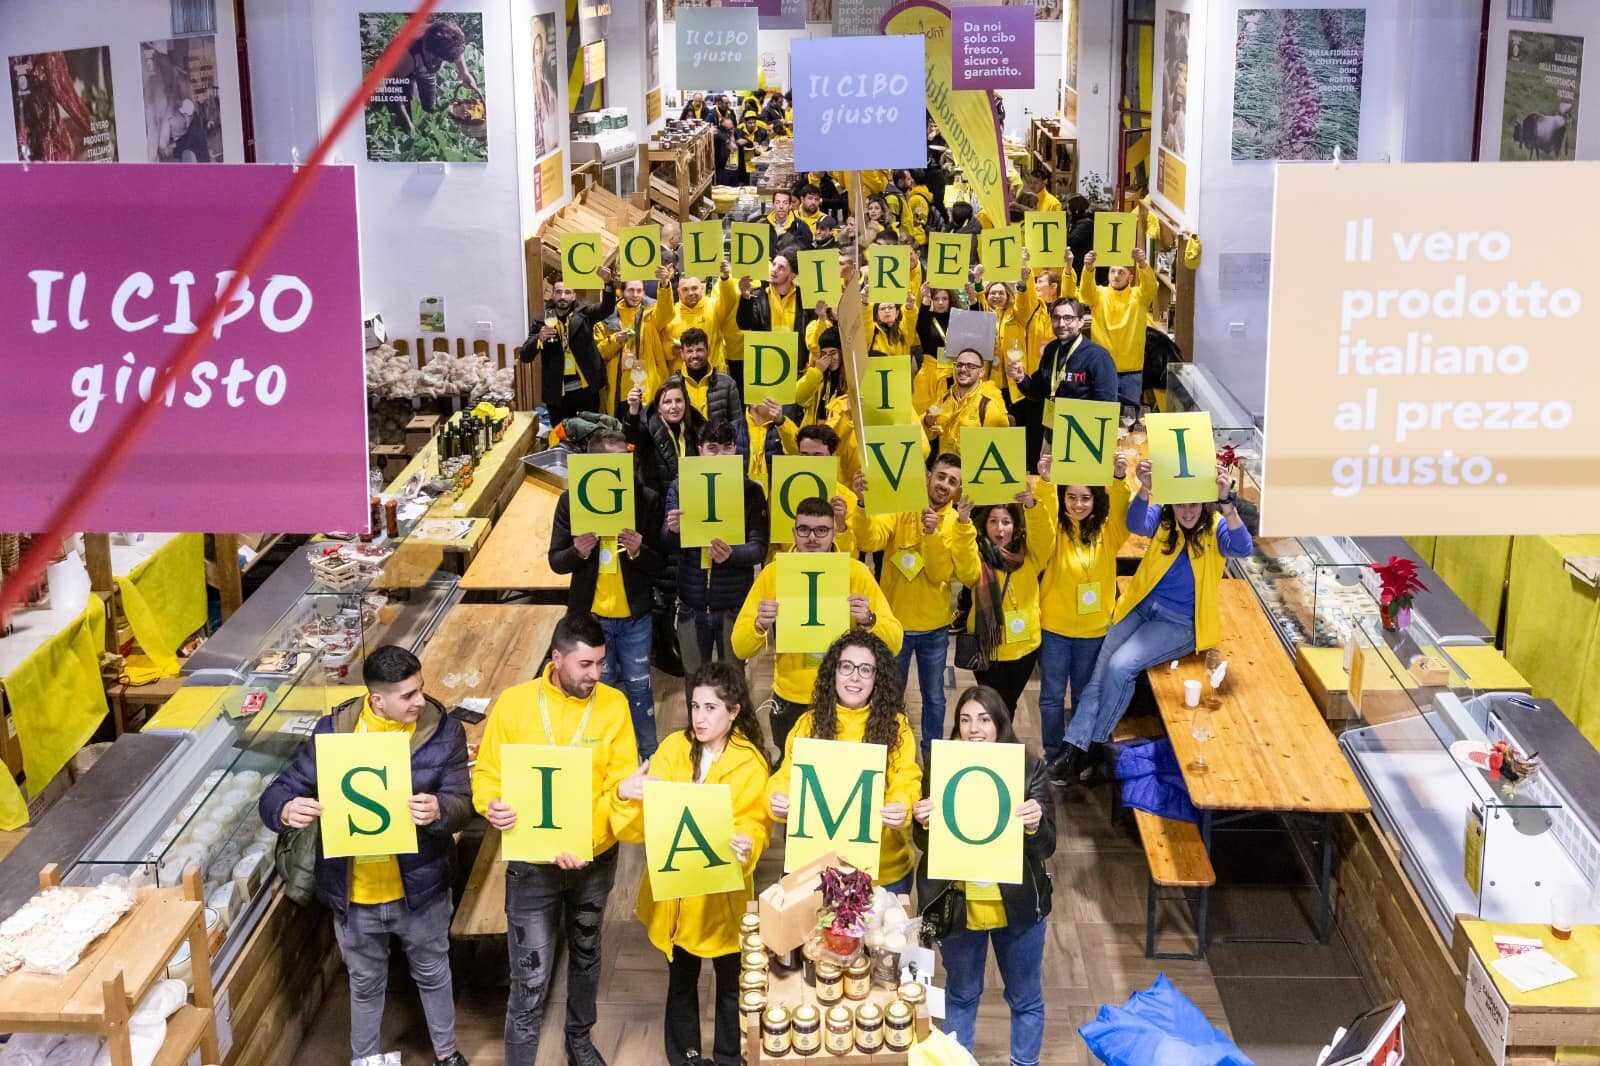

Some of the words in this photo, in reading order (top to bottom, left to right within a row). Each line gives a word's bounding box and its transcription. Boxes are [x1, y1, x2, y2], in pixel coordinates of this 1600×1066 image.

[702, 30, 749, 46] CIBO
[963, 21, 981, 32] Da
[982, 20, 1001, 31] noi
[963, 32, 988, 43] solo
[990, 31, 1016, 43] cibo
[692, 49, 742, 67] giusto
[963, 44, 1003, 55] fresco,
[963, 55, 999, 66] sicuro
[1002, 57, 1009, 65] e
[808, 74, 831, 99] Il
[836, 72, 909, 99] CIBO
[963, 65, 1022, 80] garantito.
[820, 103, 899, 135] giusto
[624, 235, 656, 268] O
[689, 230, 714, 264] L
[734, 231, 766, 265] D
[988, 235, 1017, 268] T
[1031, 220, 1060, 253] T
[1107, 221, 1123, 253] I
[1390, 229, 1512, 263] vero
[566, 242, 595, 275] C
[811, 260, 827, 293] I
[875, 255, 907, 290] R
[935, 242, 961, 275] E
[28, 269, 90, 334] Il
[110, 269, 313, 340] CIBO
[1341, 272, 1582, 333] prodotto
[750, 344, 791, 387] D
[1337, 331, 1530, 376] italiano
[69, 351, 287, 433] giusto
[876, 369, 893, 410] I
[1333, 387, 1378, 430] al
[1394, 400, 1574, 443] prezzo
[1058, 414, 1113, 465] N
[1169, 428, 1195, 479] I
[866, 441, 917, 492] V
[967, 441, 1020, 485] A
[1330, 444, 1508, 497] giusto.
[577, 467, 628, 515] G
[700, 472, 721, 523] I
[800, 571, 825, 627] I
[340, 766, 391, 837] S
[532, 766, 562, 830] I
[788, 763, 882, 846] M
[942, 766, 1011, 845] O
[658, 806, 731, 873] A
